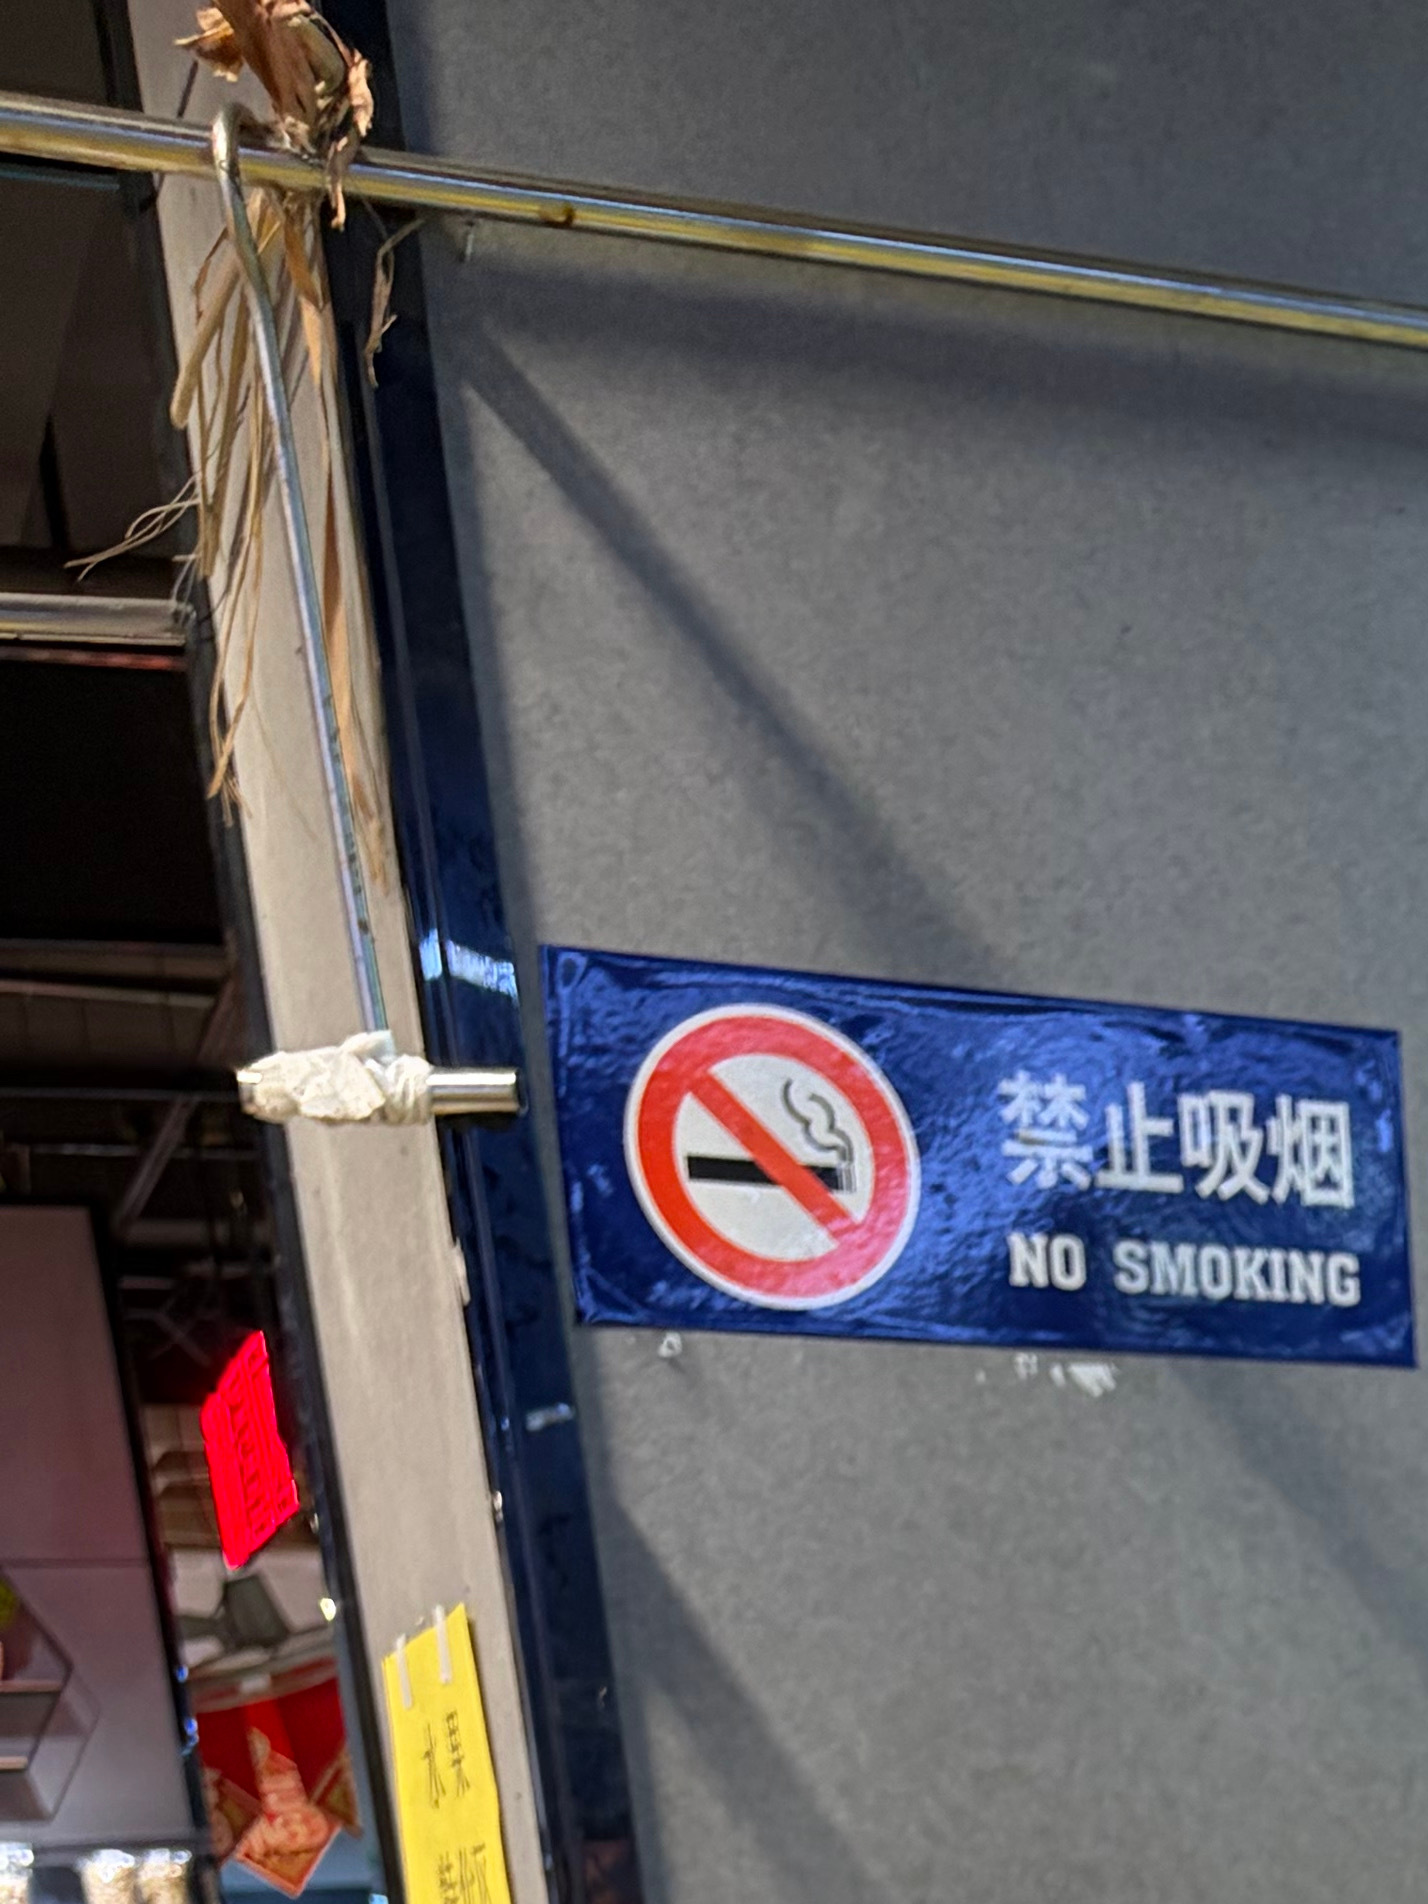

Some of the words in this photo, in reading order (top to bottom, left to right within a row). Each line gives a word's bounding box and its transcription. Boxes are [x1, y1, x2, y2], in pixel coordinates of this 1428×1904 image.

[999, 1069, 1355, 1209] 禁止吸烟
[1006, 1231, 1088, 1292] NO
[1112, 1239, 1361, 1307] SMOKING
